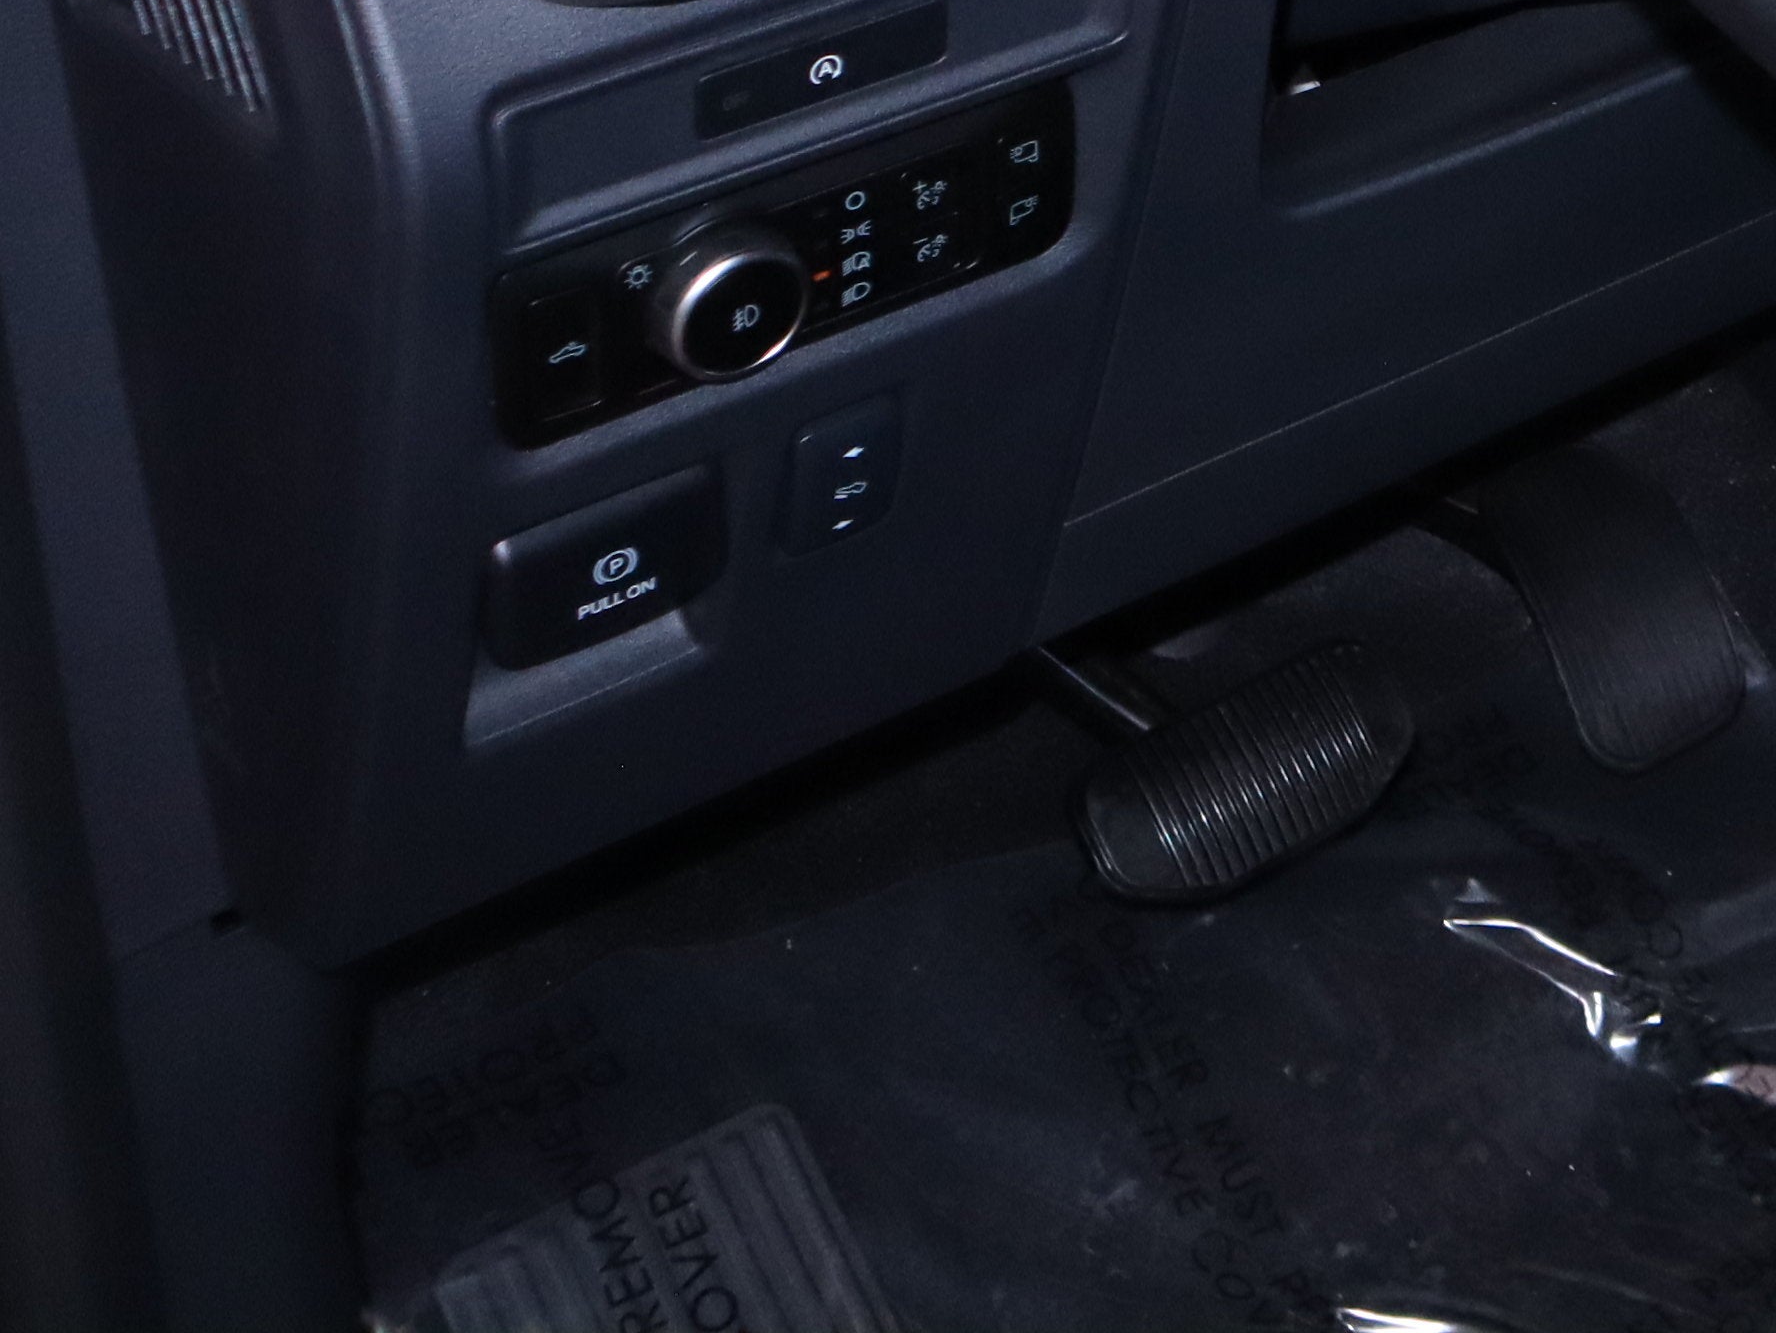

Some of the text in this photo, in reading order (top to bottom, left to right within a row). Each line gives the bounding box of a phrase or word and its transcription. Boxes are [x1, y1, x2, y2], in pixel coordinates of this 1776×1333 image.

[577, 576, 656, 620] PULL ON
[648, 1175, 748, 1333] OVER
